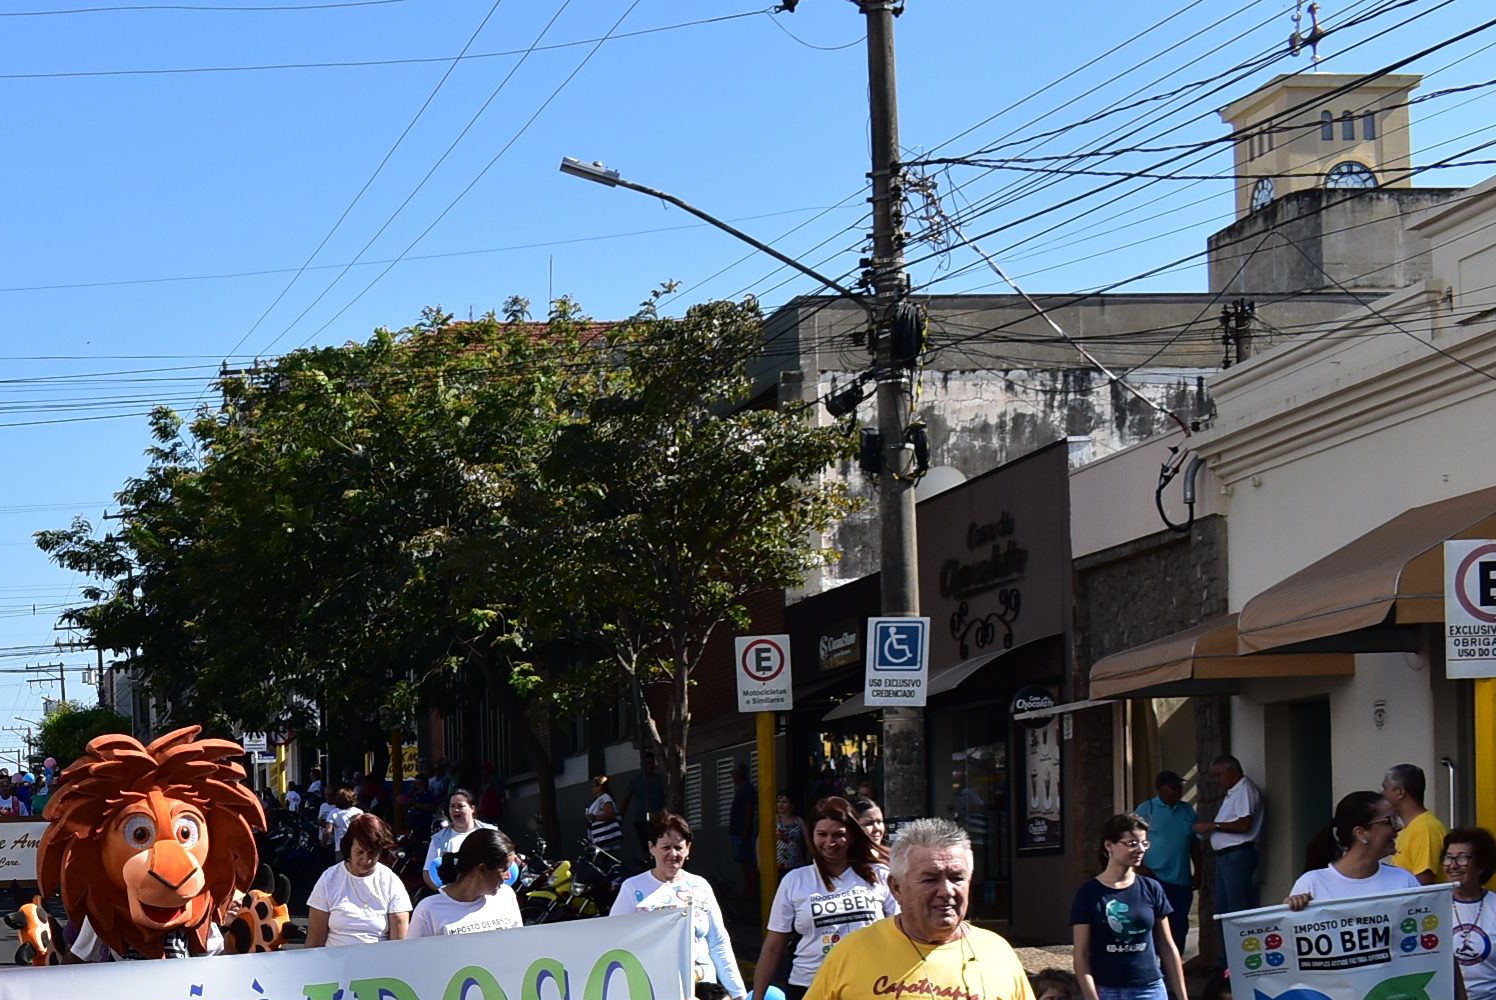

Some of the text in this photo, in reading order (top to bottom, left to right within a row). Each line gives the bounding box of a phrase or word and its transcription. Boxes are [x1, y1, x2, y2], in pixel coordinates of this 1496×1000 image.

[1458, 648, 1475, 657] USO
[755, 648, 772, 672] E
[869, 678, 921, 688] USO EXCLUSIVO
[743, 689, 787, 697] Motocicletas
[872, 689, 915, 698] CREDENCIADO
[811, 896, 877, 917] DO BEM
[1408, 907, 1431, 915] C.M.I.
[449, 924, 480, 935] IMPOSTO
[1294, 914, 1390, 934] IMPOSTO DE RENDA
[1240, 926, 1281, 937] C.M.D.C.A.
[1296, 926, 1390, 956] DO BEM
